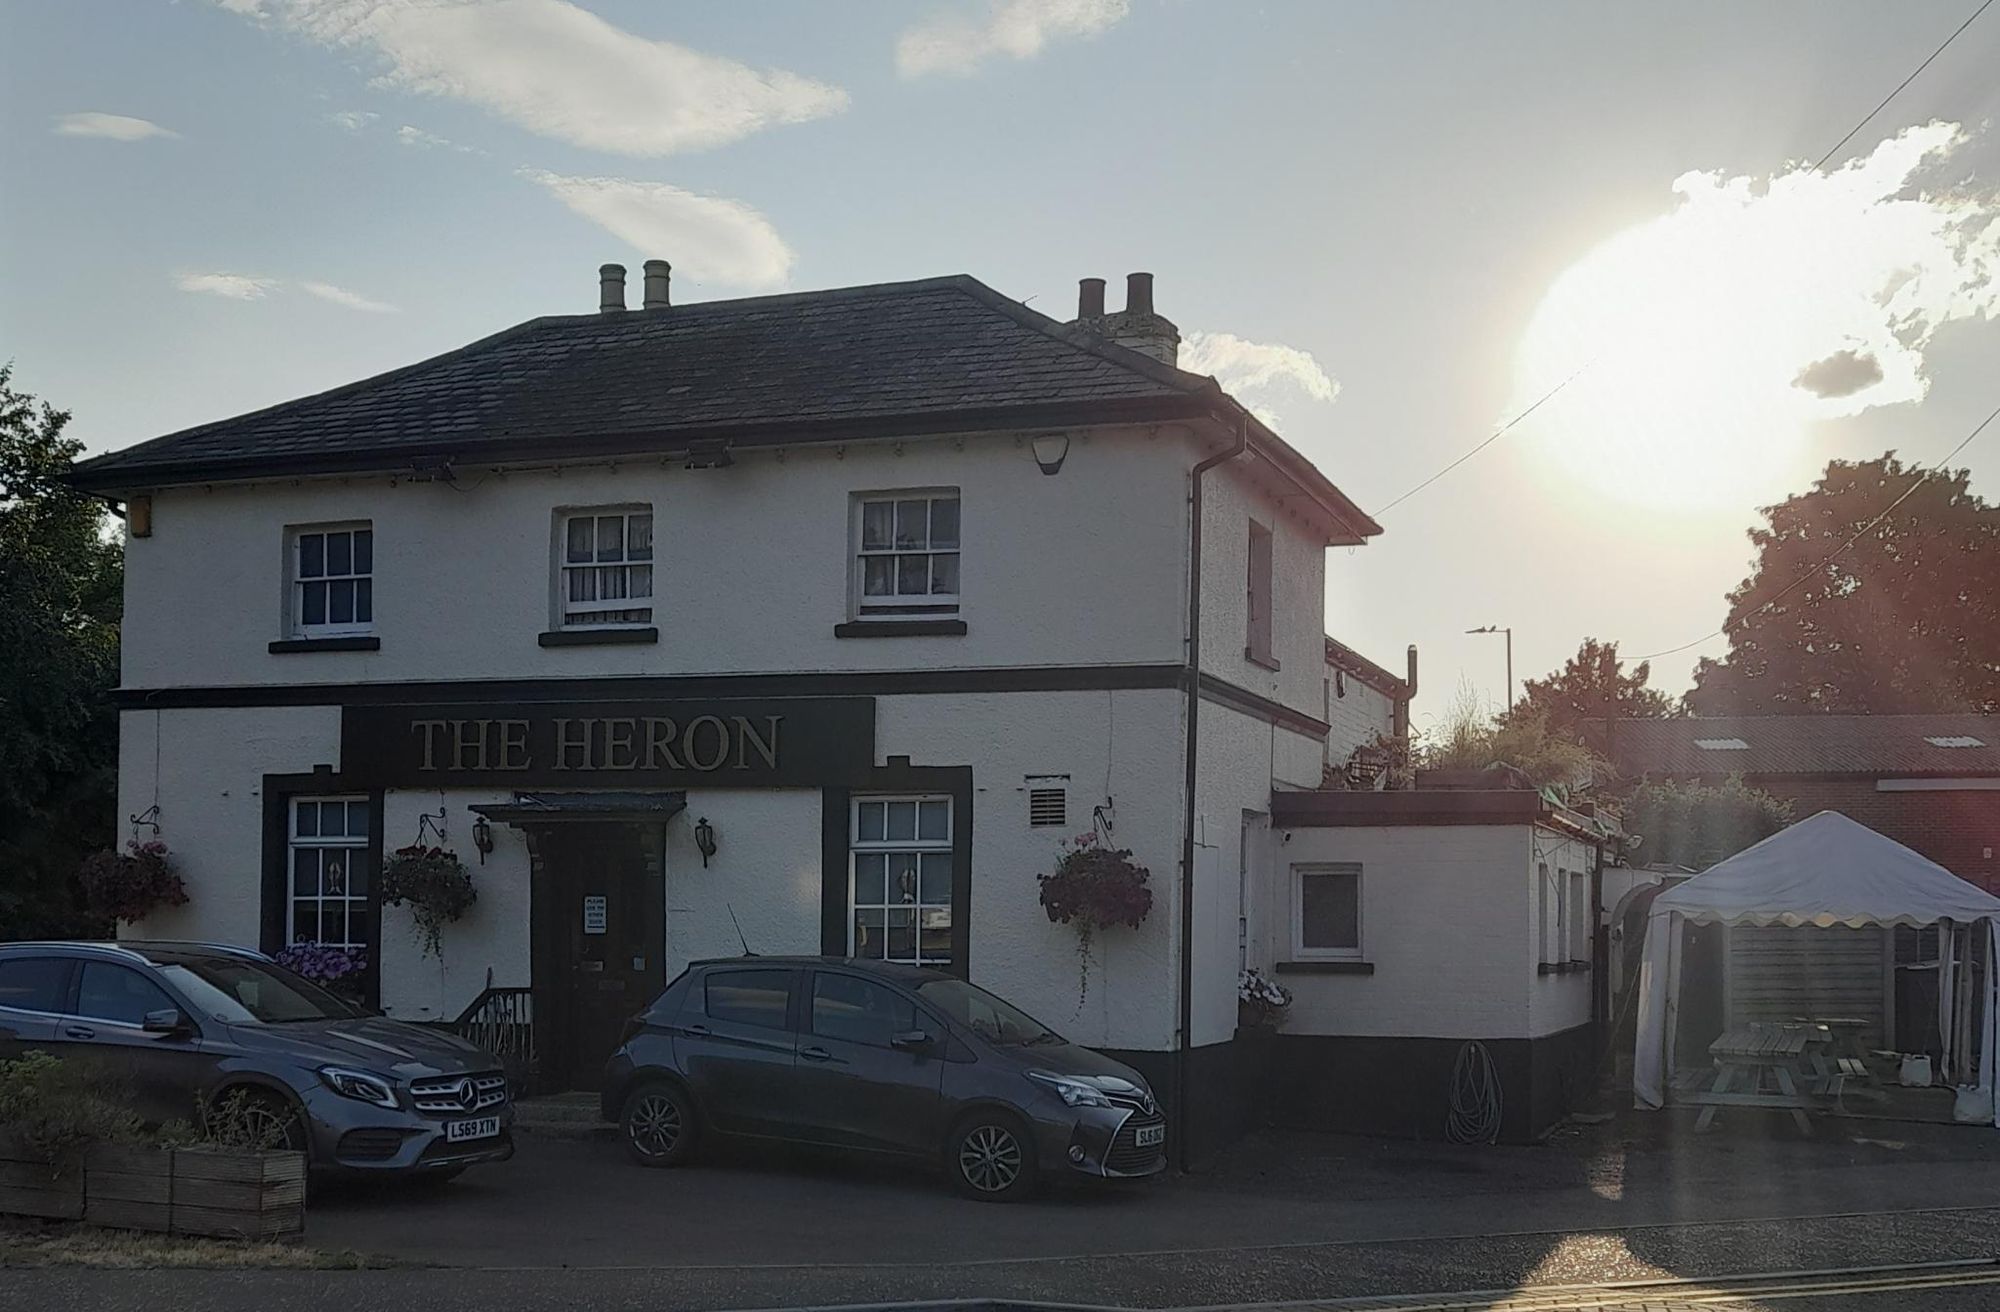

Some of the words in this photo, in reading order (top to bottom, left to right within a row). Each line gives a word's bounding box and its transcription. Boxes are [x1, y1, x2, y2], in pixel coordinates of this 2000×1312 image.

[411, 718, 533, 772] THE
[551, 714, 785, 771] HERON
[451, 1121, 477, 1138] LS69
[479, 1118, 497, 1134] XTN
